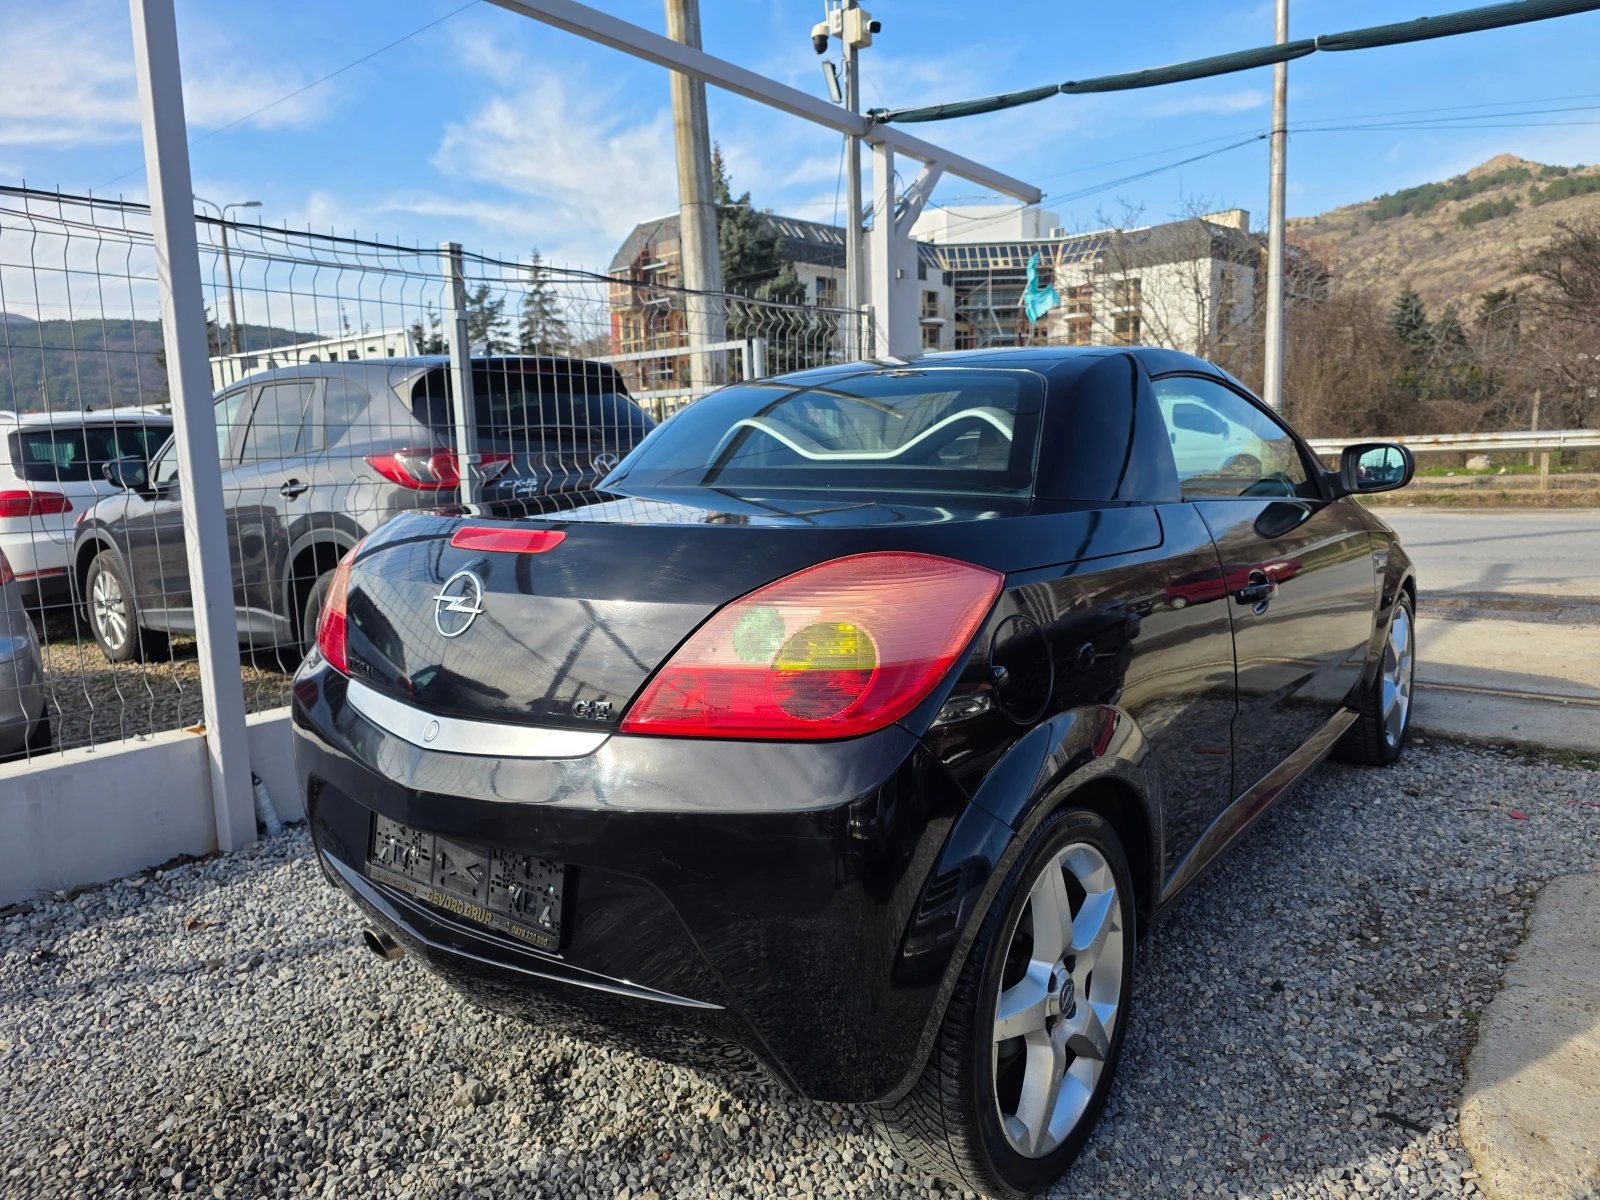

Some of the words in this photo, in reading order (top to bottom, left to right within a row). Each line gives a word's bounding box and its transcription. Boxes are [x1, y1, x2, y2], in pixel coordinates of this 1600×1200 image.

[499, 478, 538, 488] CX-5
[428, 889, 463, 915] GEVORG
[463, 902, 493, 925] GRUP
